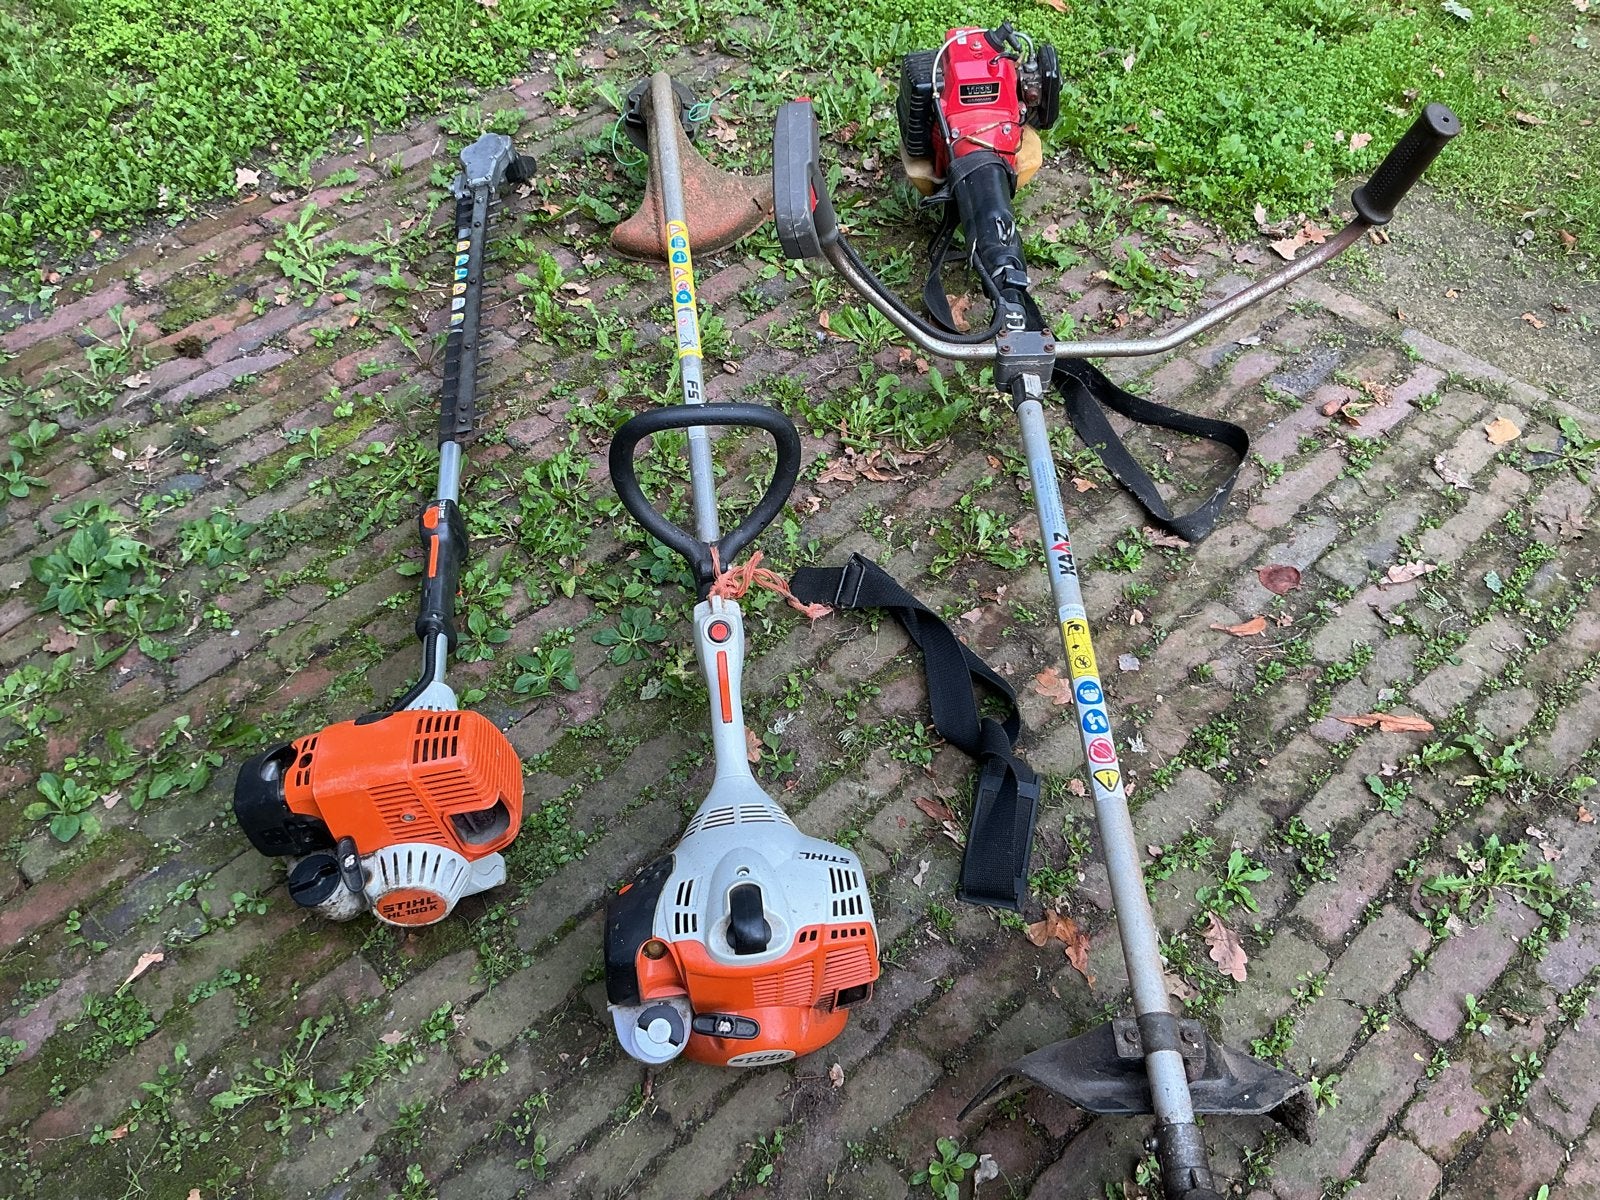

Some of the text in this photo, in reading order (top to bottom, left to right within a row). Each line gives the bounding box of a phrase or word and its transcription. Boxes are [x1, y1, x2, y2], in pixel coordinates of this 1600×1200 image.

[687, 380, 700, 400] FS
[1050, 532, 1077, 577] KAAZ
[799, 851, 851, 865] STIHL
[383, 896, 438, 914] STIHL
